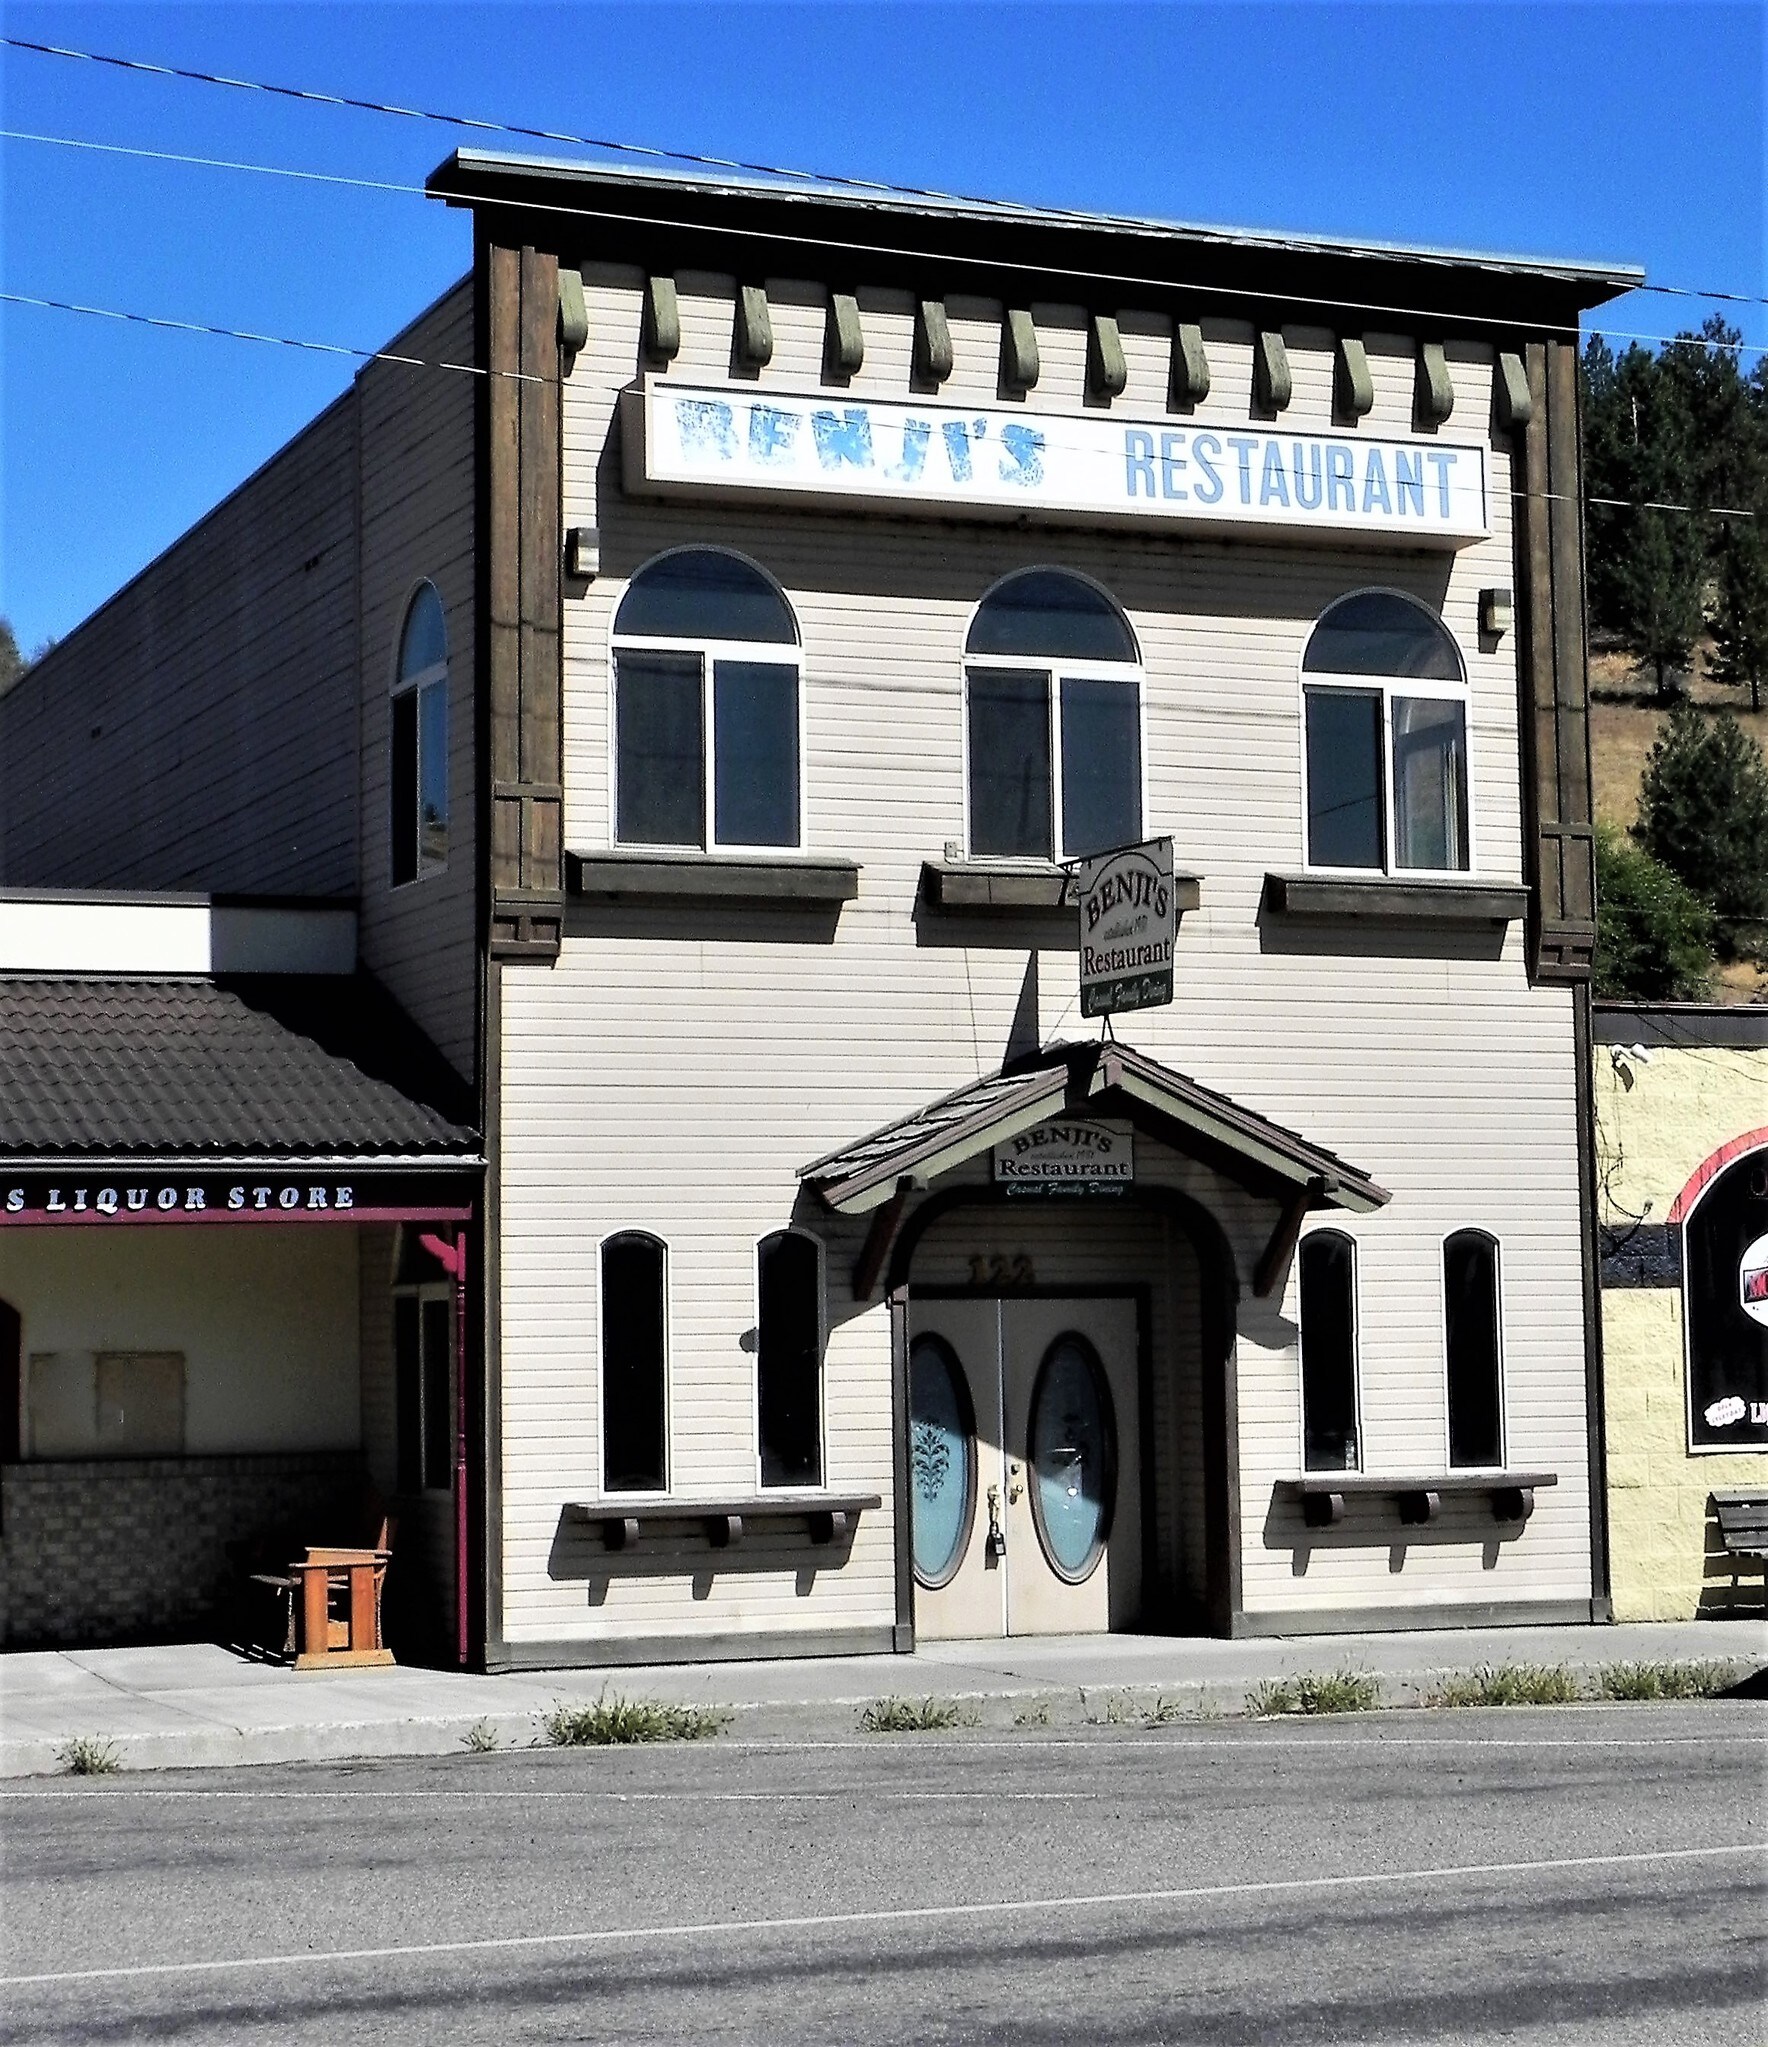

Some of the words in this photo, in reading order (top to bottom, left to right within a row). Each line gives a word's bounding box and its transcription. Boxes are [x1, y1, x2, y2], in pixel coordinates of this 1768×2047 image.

[1125, 430, 1458, 518] RESTAURANT
[1088, 870, 1168, 932] BENJI'S
[1084, 938, 1170, 976] Restaurant
[1012, 1127, 1113, 1156] BENJI'S
[1000, 1159, 1128, 1176] Restaurant
[6, 1188, 25, 1211] S
[46, 1187, 207, 1214] LIQUOR
[227, 1186, 354, 1209] STORE
